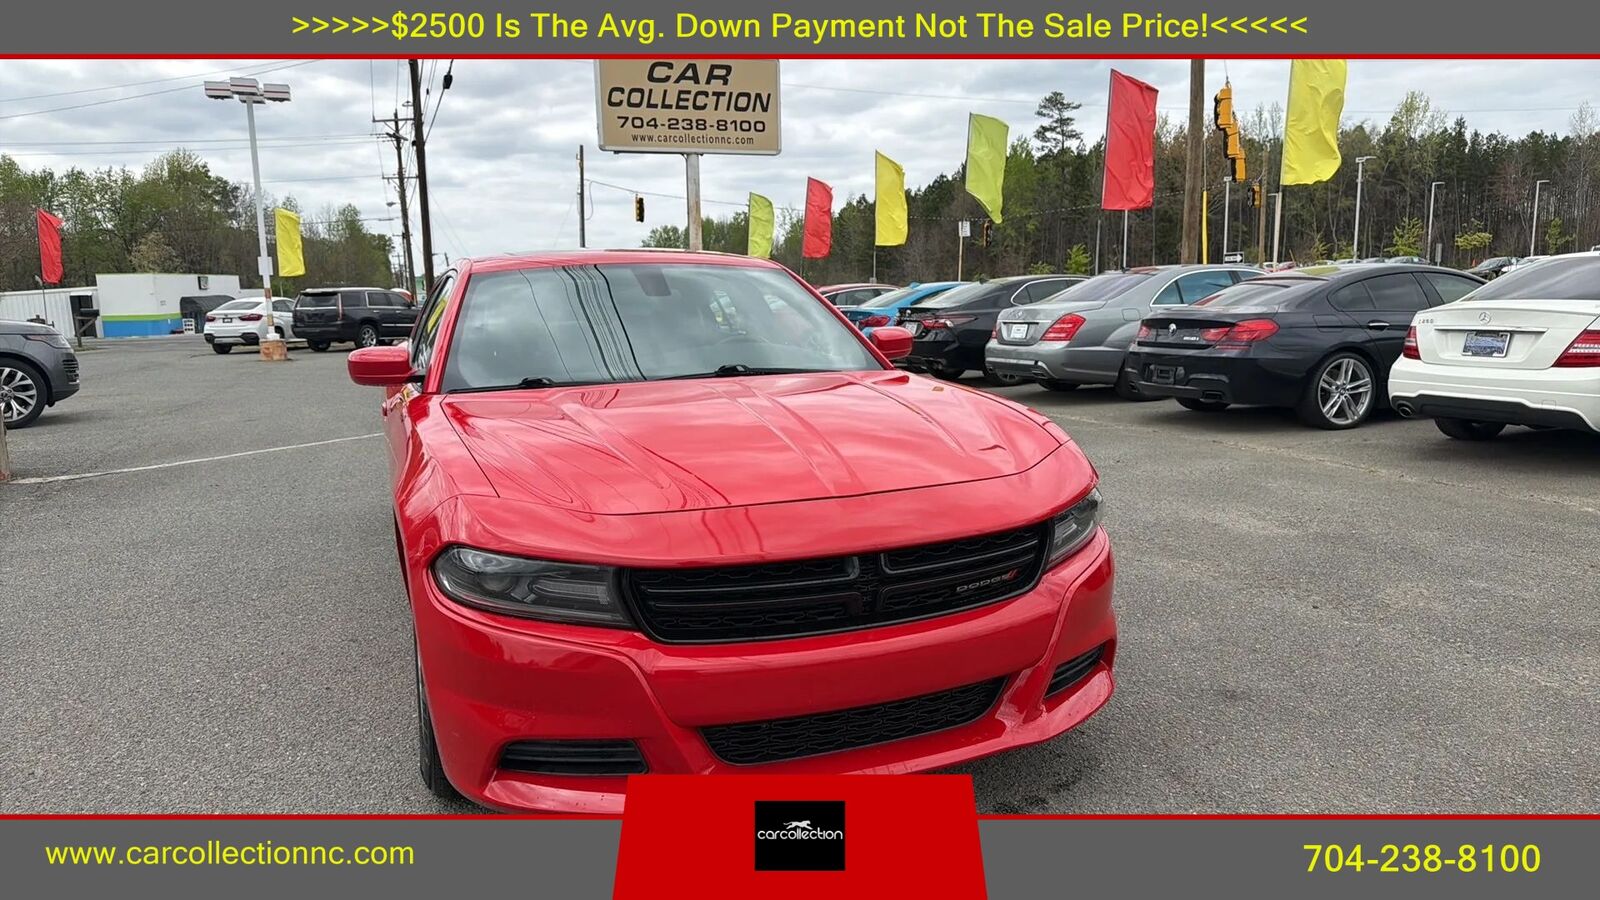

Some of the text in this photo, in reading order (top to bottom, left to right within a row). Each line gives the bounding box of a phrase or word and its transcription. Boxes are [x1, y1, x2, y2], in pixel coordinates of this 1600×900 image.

[646, 61, 733, 86] CAR
[607, 86, 772, 113] COLLECTION
[616, 115, 766, 133] 704-238-8100
[630, 133, 754, 145] www.carcollectionnc.com
[956, 573, 1008, 592] DODGE
